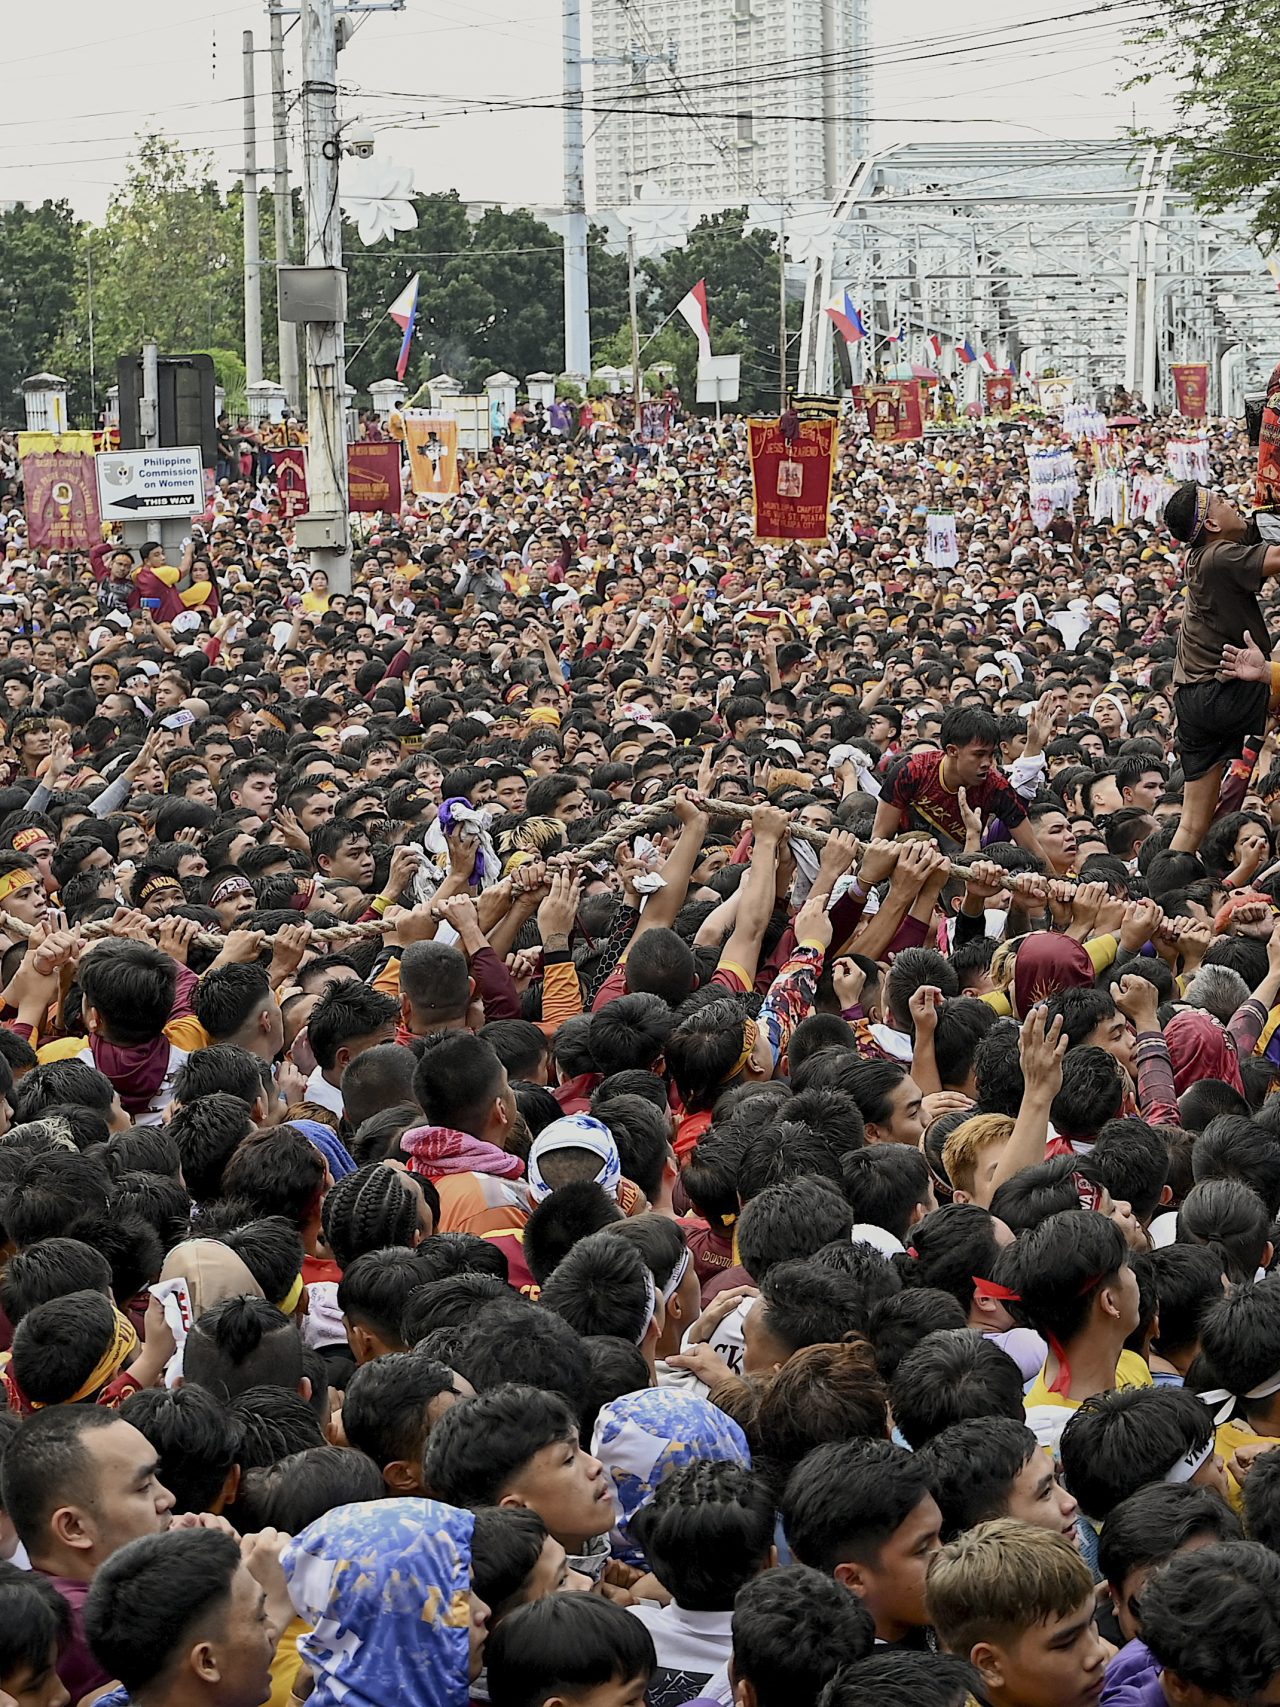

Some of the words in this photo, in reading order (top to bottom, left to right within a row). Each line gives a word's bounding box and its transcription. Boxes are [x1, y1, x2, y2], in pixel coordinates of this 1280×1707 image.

[144, 458, 192, 467] Philippine
[139, 468, 198, 478] Commission
[159, 480, 194, 488] Women
[144, 497, 168, 506] THIS
[170, 496, 192, 504] WAY
[797, 505, 823, 513] CHAPTER
[1184, 1440, 1210, 1468] VIVA
